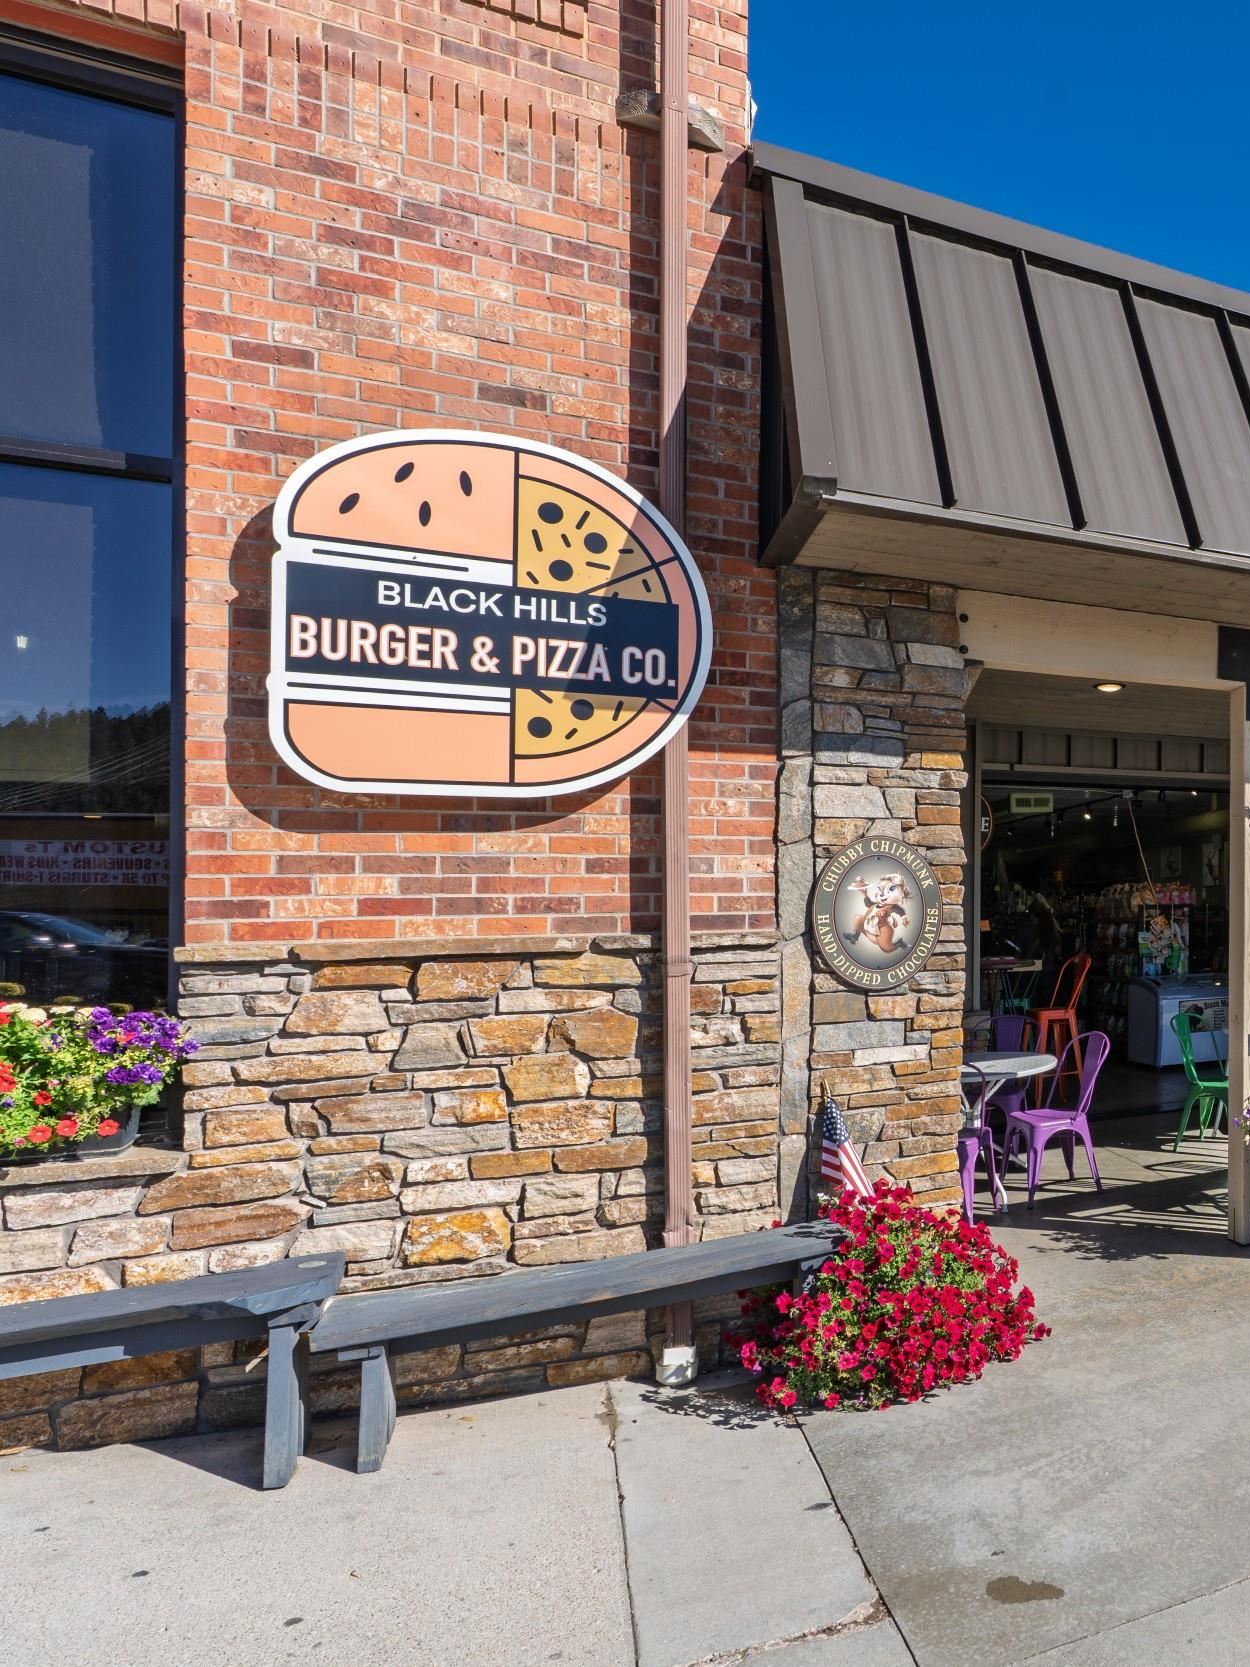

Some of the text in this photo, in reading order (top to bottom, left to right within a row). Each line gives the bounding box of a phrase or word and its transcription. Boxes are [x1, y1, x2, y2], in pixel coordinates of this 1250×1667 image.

[376, 580, 607, 627] BLACK HILLS
[289, 614, 677, 688] BURGER & PIZZA CO.
[822, 840, 934, 892] CHUBBY CHIPMUNK
[818, 908, 939, 985] HAND-DIPPED CHOCOLATES
